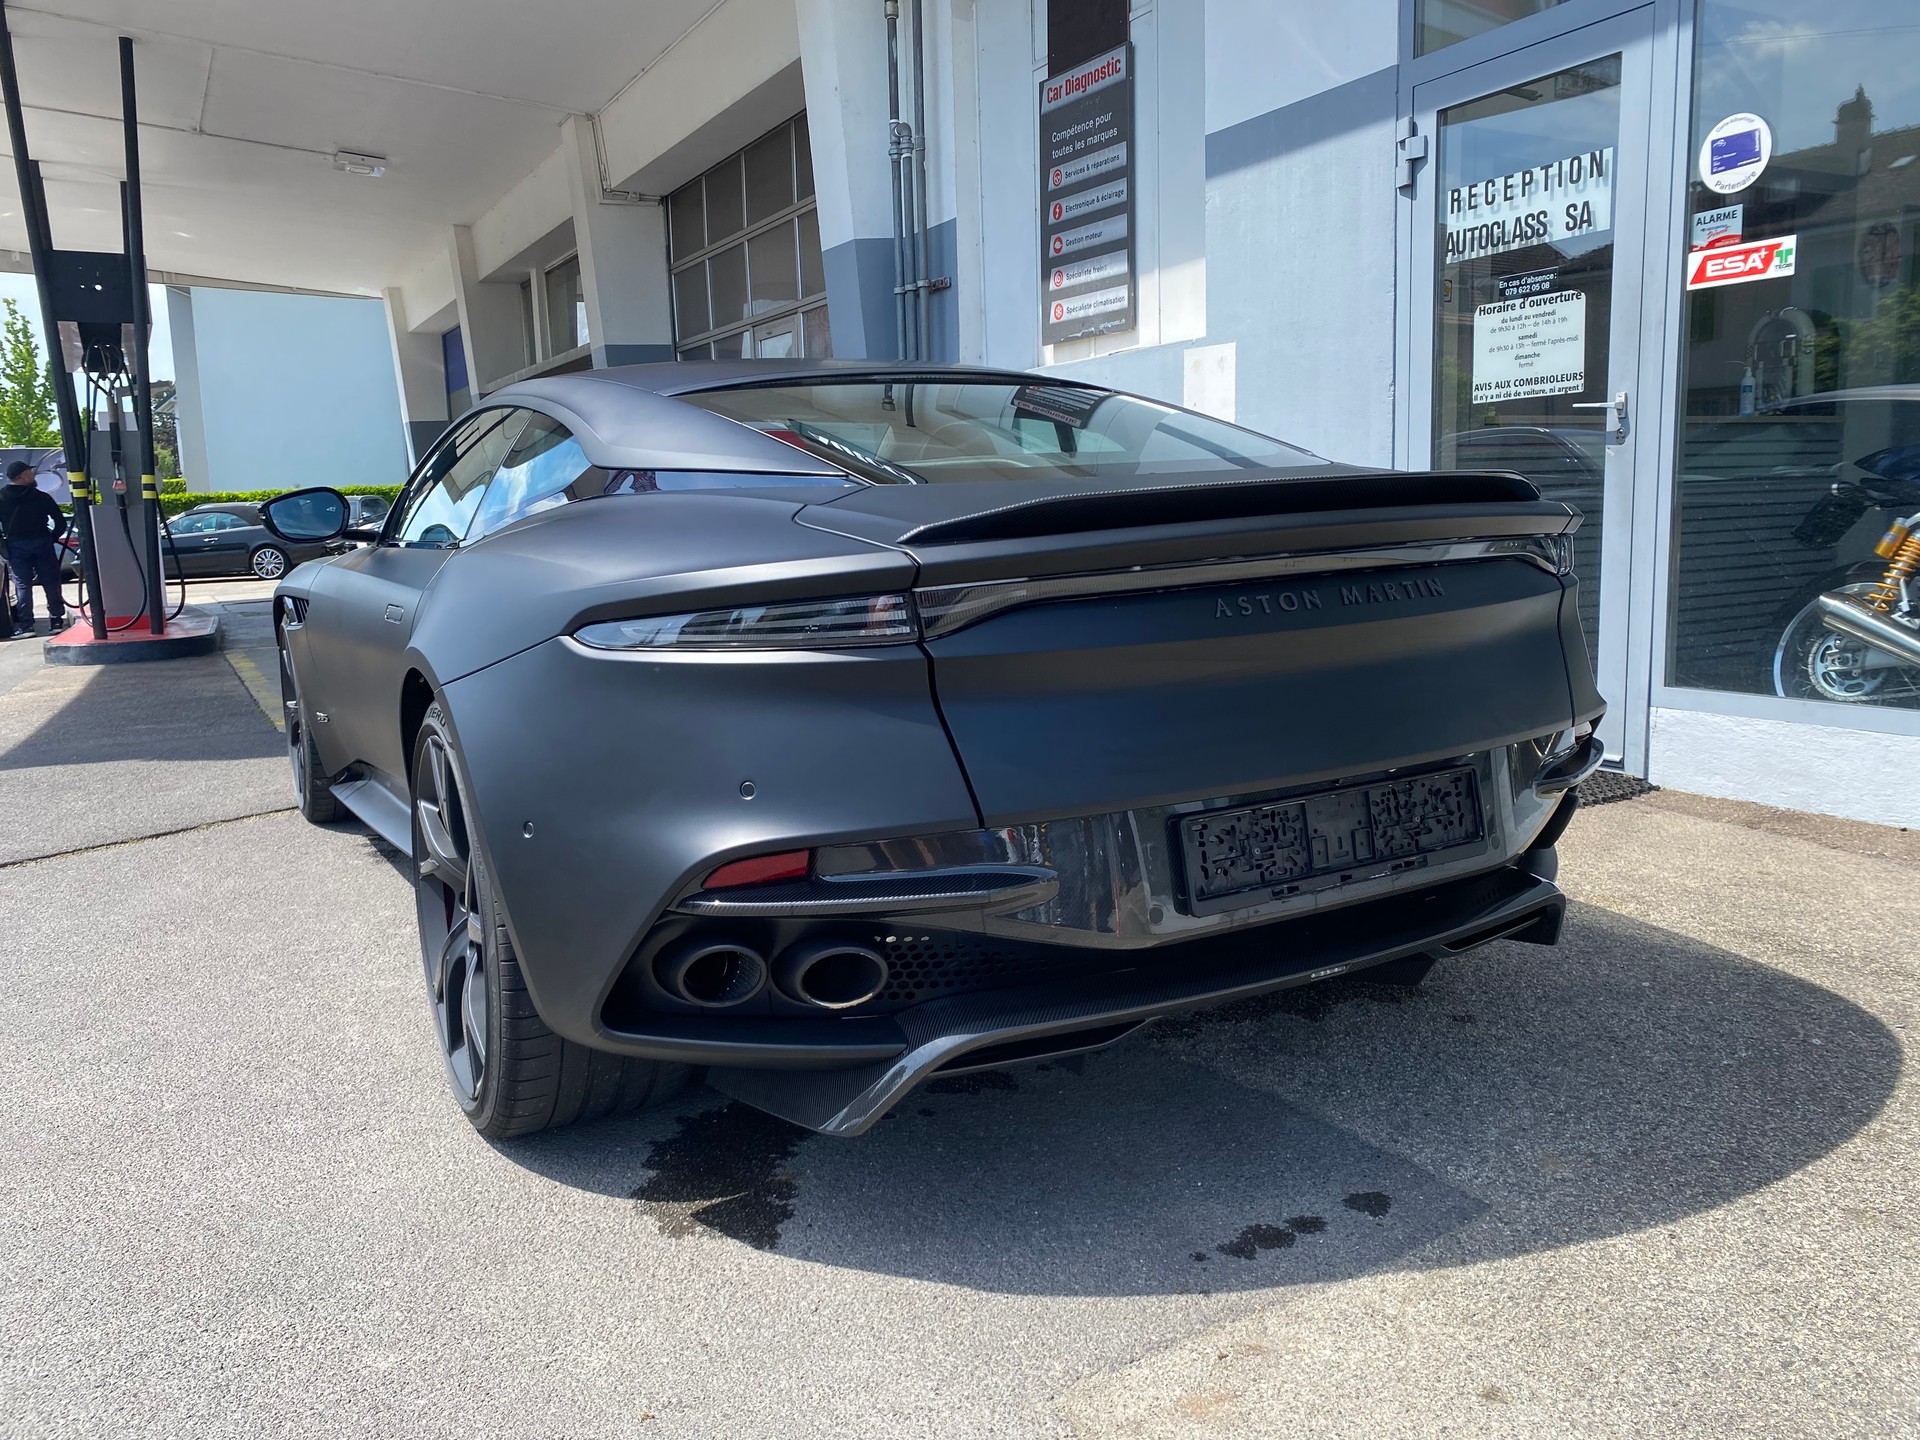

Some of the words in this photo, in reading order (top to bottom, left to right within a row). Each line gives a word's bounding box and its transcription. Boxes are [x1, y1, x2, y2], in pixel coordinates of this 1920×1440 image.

[1047, 84, 1063, 104] Car
[1065, 57, 1121, 96] Diagnostic
[1052, 119, 1094, 143] Compétence
[1095, 112, 1113, 128] pour
[1052, 144, 1073, 159] toutes
[1075, 140, 1085, 151] les
[1086, 127, 1118, 146] marques
[1064, 165, 1086, 179] Services
[1091, 154, 1120, 170] réparations
[1450, 149, 1604, 215] RECEPTION
[1714, 171, 1757, 190] Partenaire
[1065, 198, 1096, 213] Electronique
[1101, 189, 1125, 202] éclairage
[1696, 209, 1738, 226] ALARME
[1445, 210, 1548, 258] AUTOCLASS
[1565, 200, 1593, 232] SA
[1065, 236, 1084, 247] Gestion
[1085, 231, 1103, 242] moteur
[1065, 268, 1092, 281] Spéciaste
[1499, 281, 1507, 289] En
[1508, 279, 1520, 287] cas
[1505, 288, 1517, 296] 079
[1518, 285, 1531, 294] 622
[1541, 281, 1550, 290] 08
[1066, 302, 1092, 315] Spécialiste
[1478, 302, 1516, 317] Horaire
[1519, 291, 1582, 310] d'ouverture
[1509, 314, 1523, 323] lundi
[1532, 309, 1557, 319] vendredi
[1518, 332, 1538, 341] samedi
[1514, 352, 1541, 361] dimanche
[1519, 361, 1534, 369] fermé
[1474, 382, 1492, 392] AVIS
[1494, 380, 1511, 390] AUX
[1513, 371, 1584, 388] COMBRIOLEURS
[1480, 393, 1488, 402] n'y
[1495, 391, 1502, 399] ni
[1503, 390, 1512, 398] clé
[1513, 389, 1521, 397] de
[1549, 386, 1556, 394] ni
[1557, 383, 1579, 395] argent
[1215, 589, 1322, 618] ASTON
[1340, 577, 1445, 606] MARTIN
